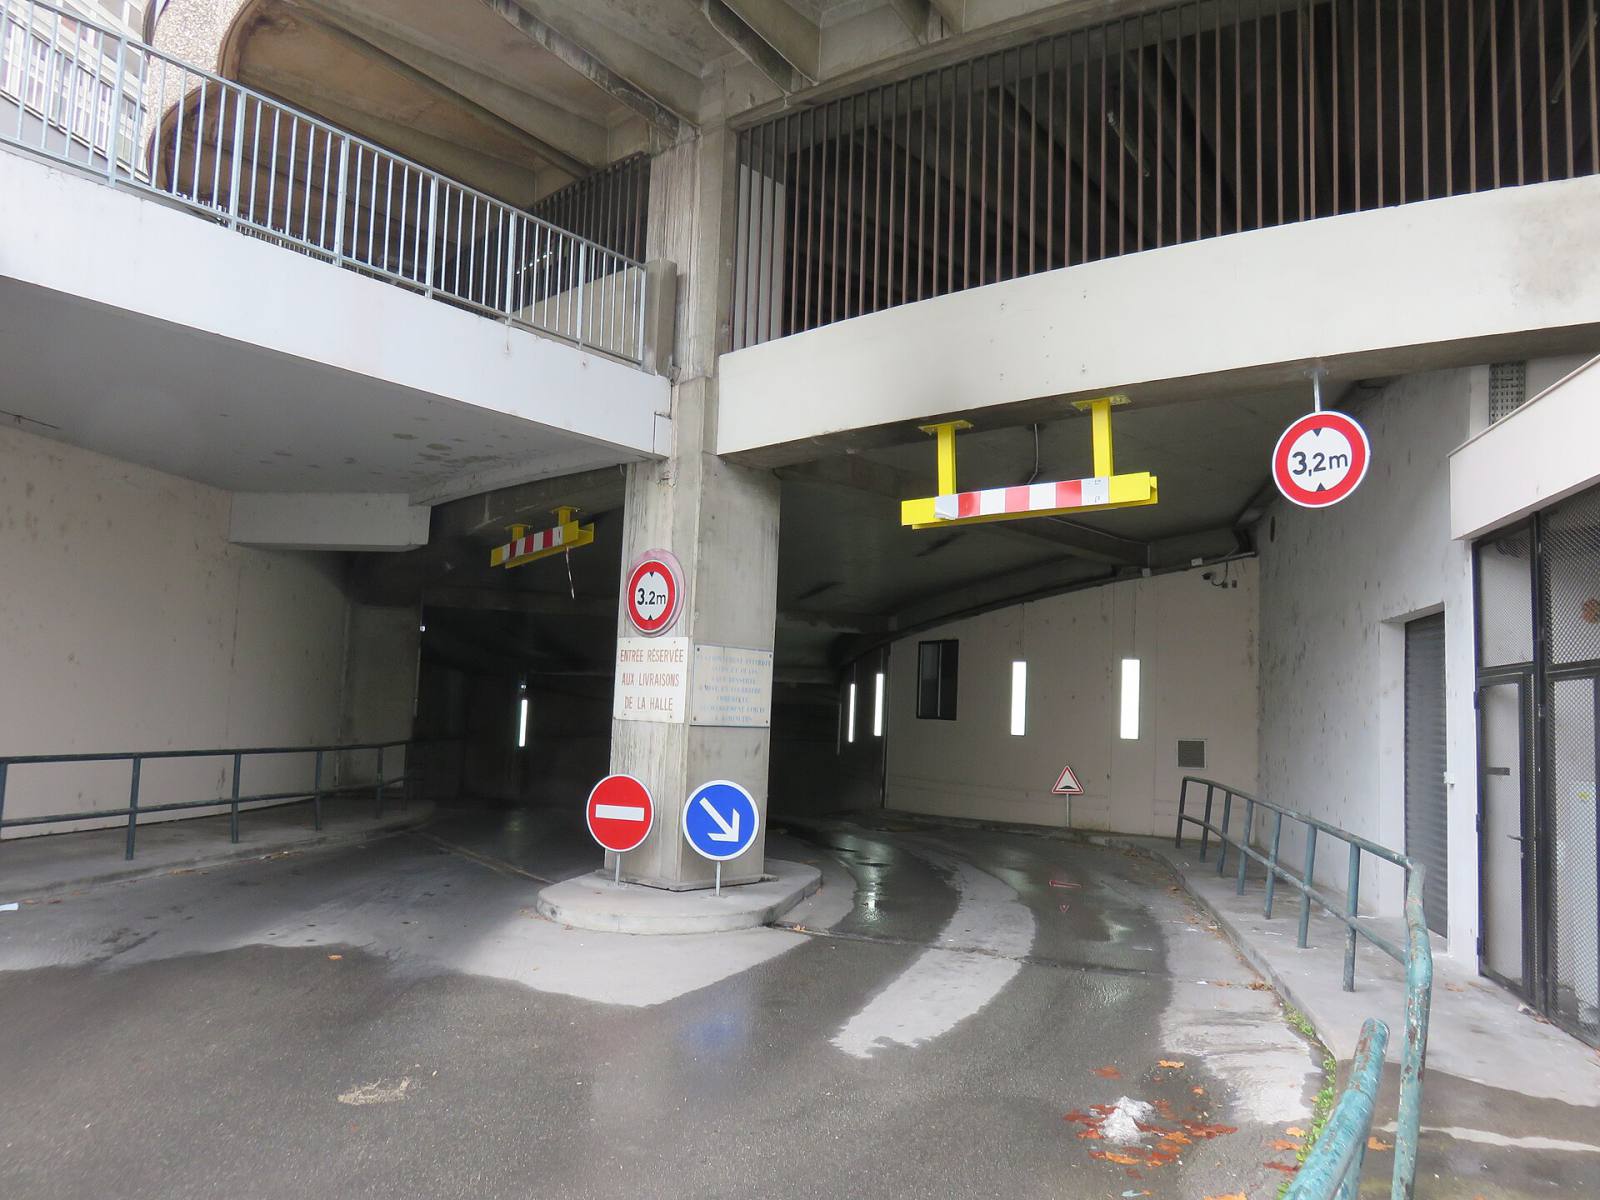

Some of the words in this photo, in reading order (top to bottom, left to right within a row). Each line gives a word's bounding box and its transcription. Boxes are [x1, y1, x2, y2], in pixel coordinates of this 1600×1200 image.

[1292, 451, 1348, 477] 3,2m
[637, 587, 666, 605] 3.2m
[620, 648, 643, 662] ENTRÉE
[647, 648, 684, 662] RÉSERVÉE
[622, 672, 635, 686] AUX
[639, 672, 680, 687] LIVRAISONS
[624, 696, 633, 709] DE
[637, 697, 646, 710] LA
[650, 697, 673, 711] HALLE
